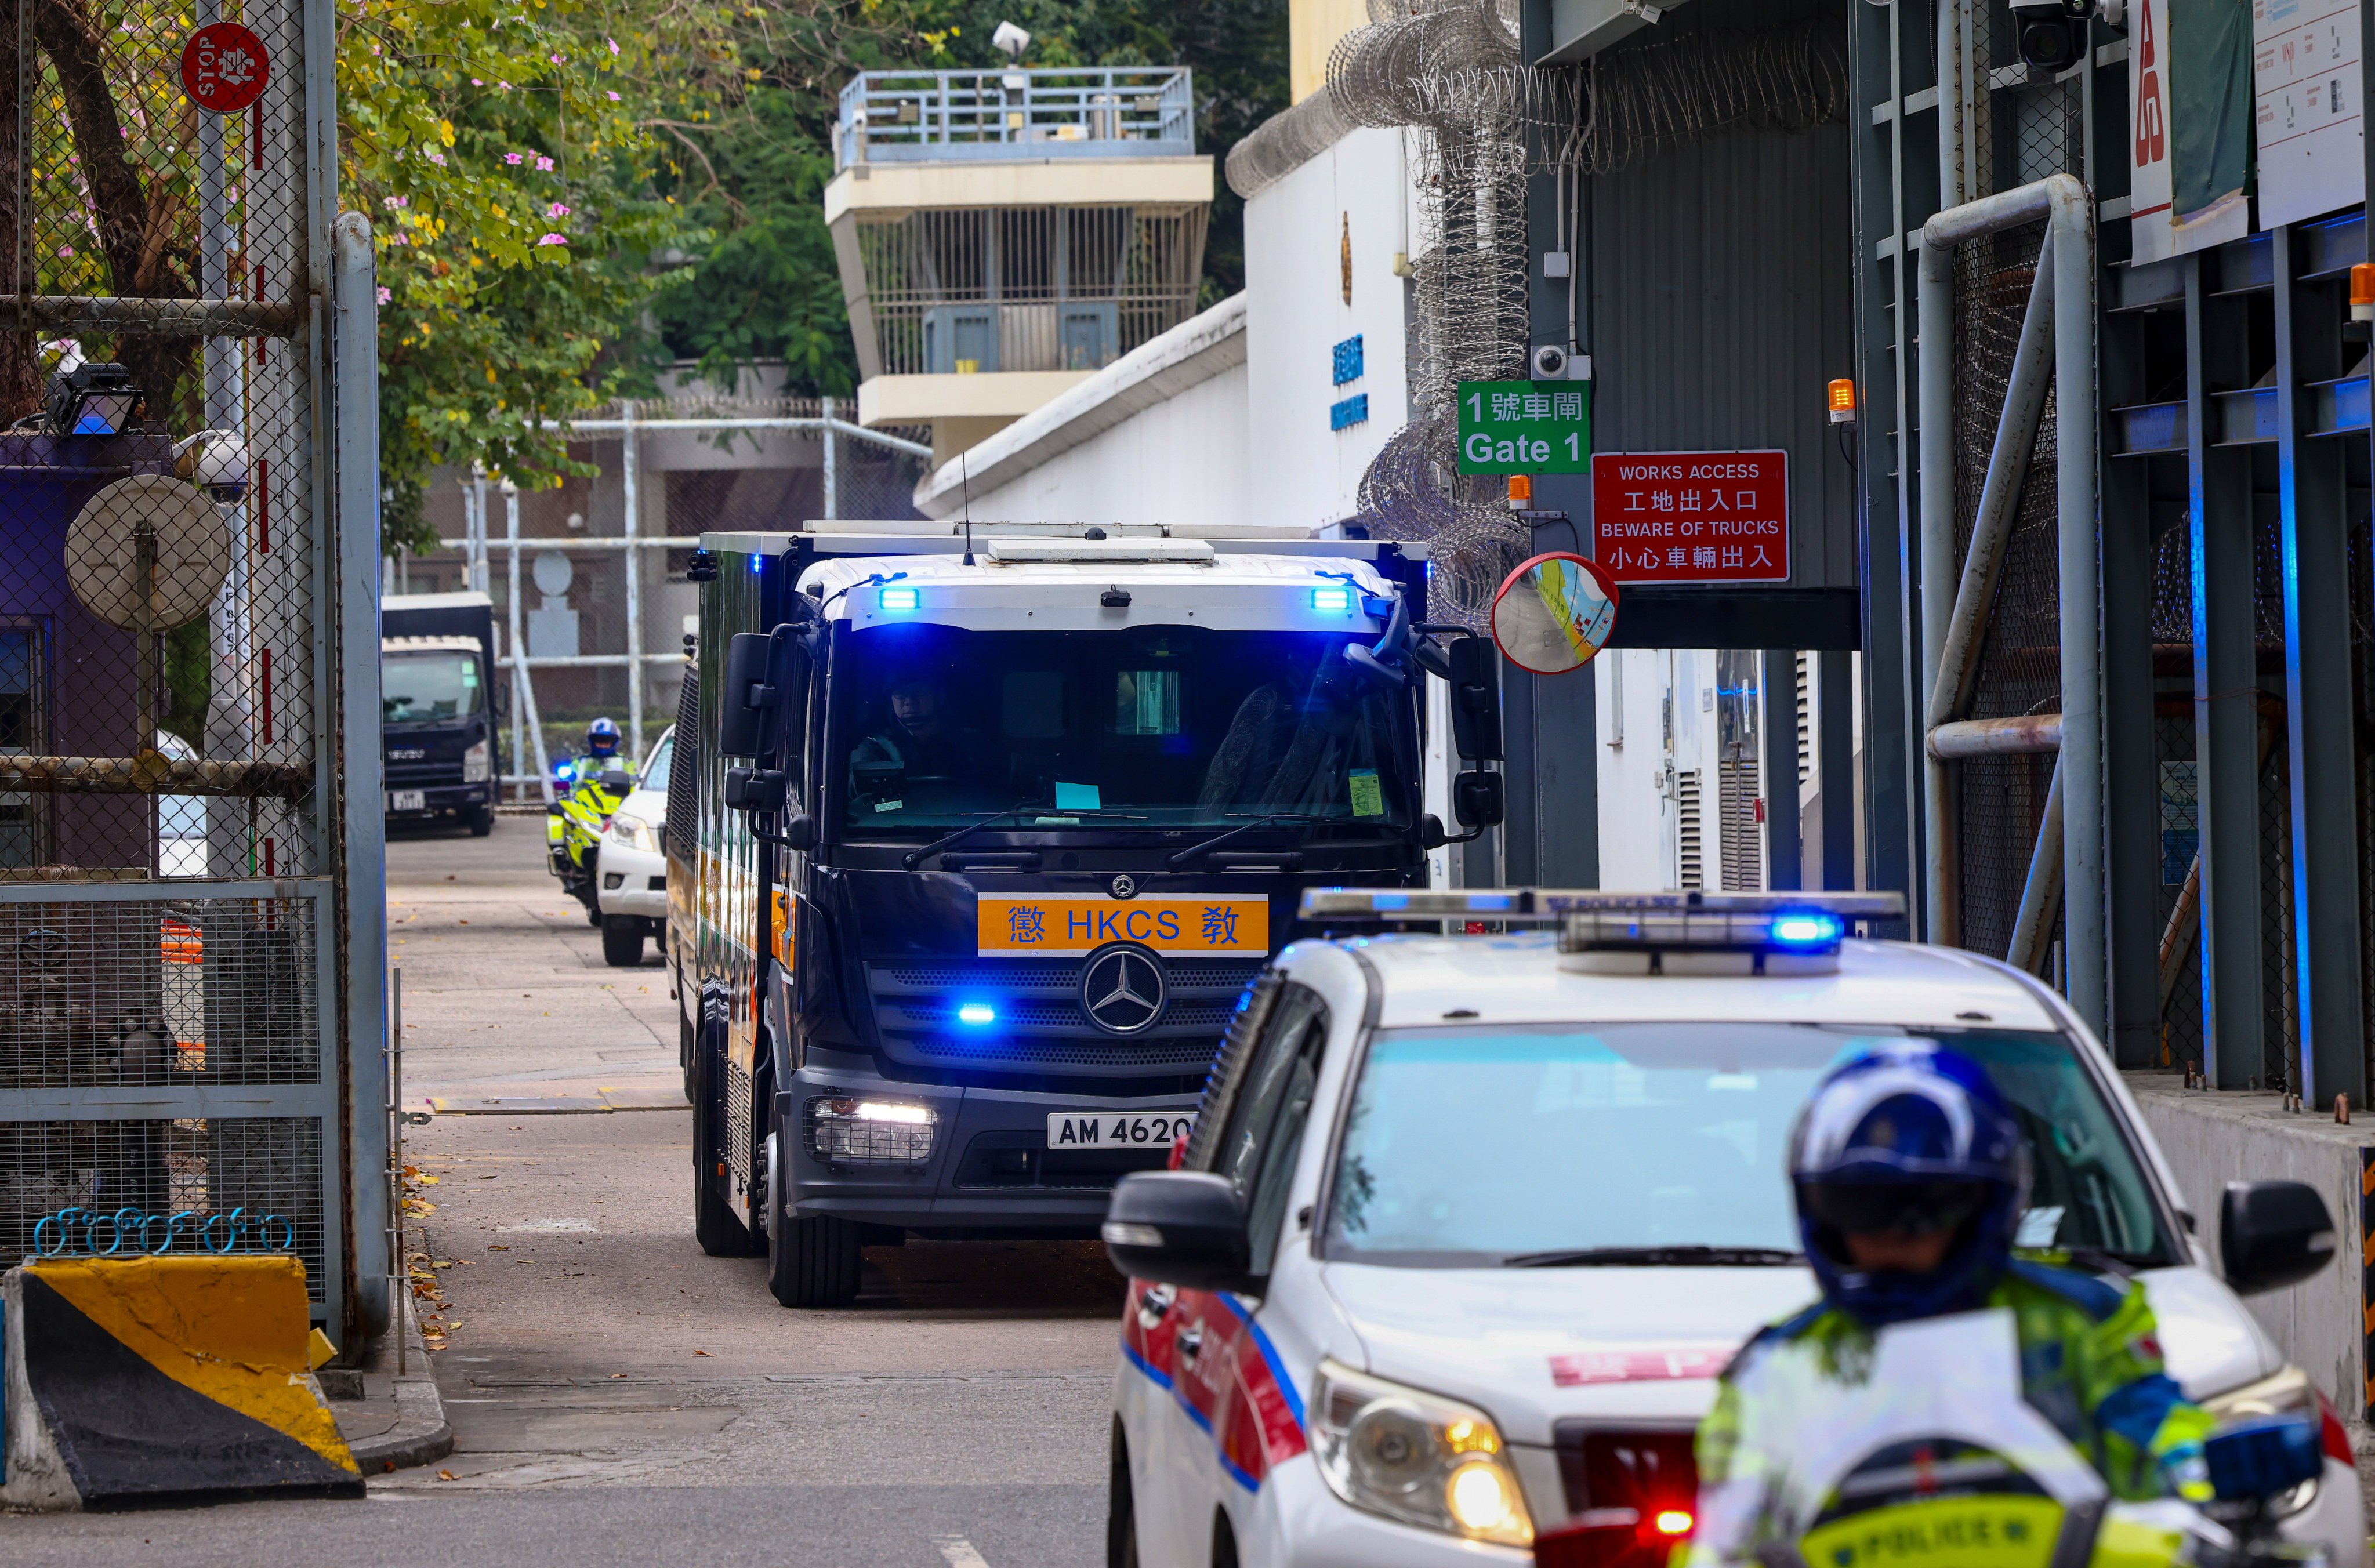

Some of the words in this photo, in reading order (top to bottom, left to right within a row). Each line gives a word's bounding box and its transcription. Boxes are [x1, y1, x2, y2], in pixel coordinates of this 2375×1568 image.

[198, 37, 215, 96] STOP
[218, 48, 255, 86] 停
[1466, 433, 1550, 463] Gate
[1564, 432, 1579, 462] 1
[1619, 466, 1683, 480] WORKS
[1689, 464, 1760, 479] ACCESS
[1623, 489, 1756, 512] 工地出入口
[1602, 522, 1674, 537] BEWARE
[1680, 522, 1704, 536] OF
[1709, 520, 1779, 535] TRUCKS
[1609, 545, 1772, 569] 小心車輛出入
[1009, 906, 1046, 943] 懲
[1068, 910, 1180, 940] HKCS
[1058, 1119, 1099, 1144] AM
[1109, 1118, 1190, 1143] 4620
